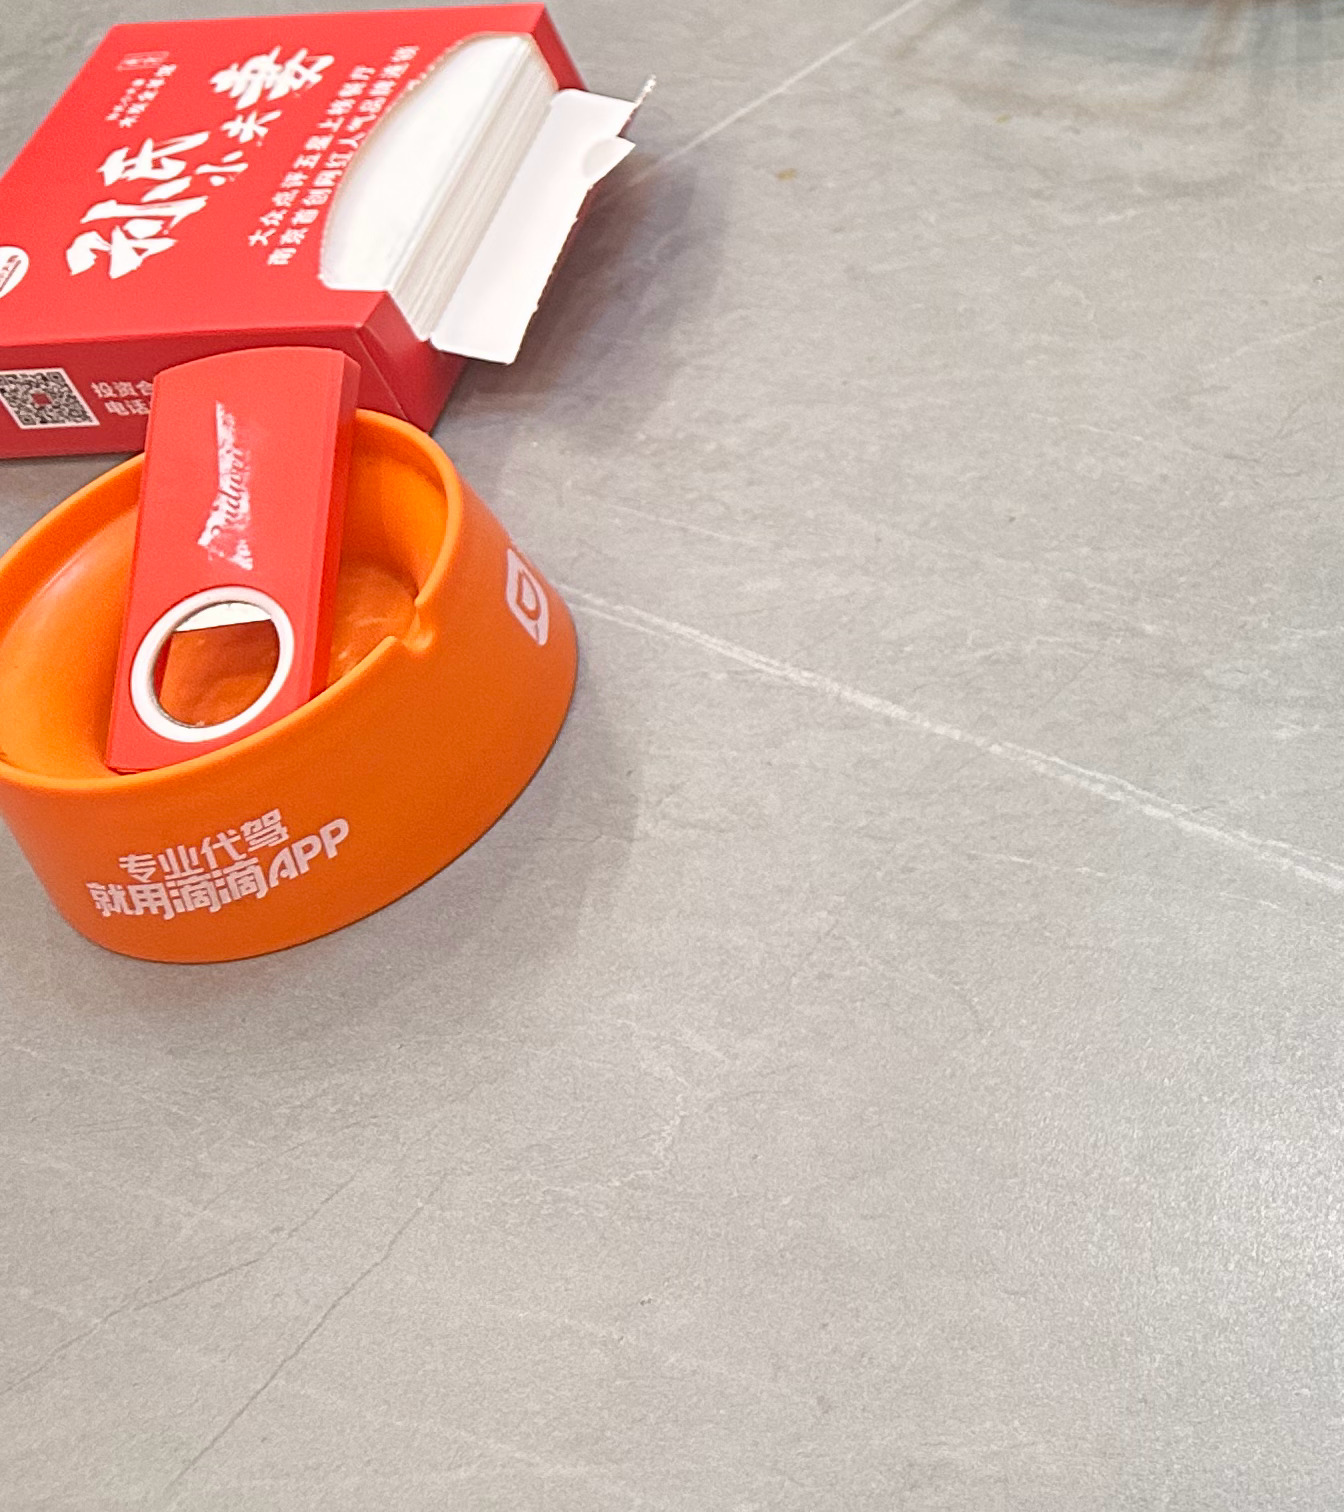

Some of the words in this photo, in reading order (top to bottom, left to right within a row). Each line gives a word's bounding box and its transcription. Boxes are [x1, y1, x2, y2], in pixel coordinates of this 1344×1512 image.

[85, 818, 349, 920] 就用滴滴APP
[118, 808, 289, 883] 专业代驾
